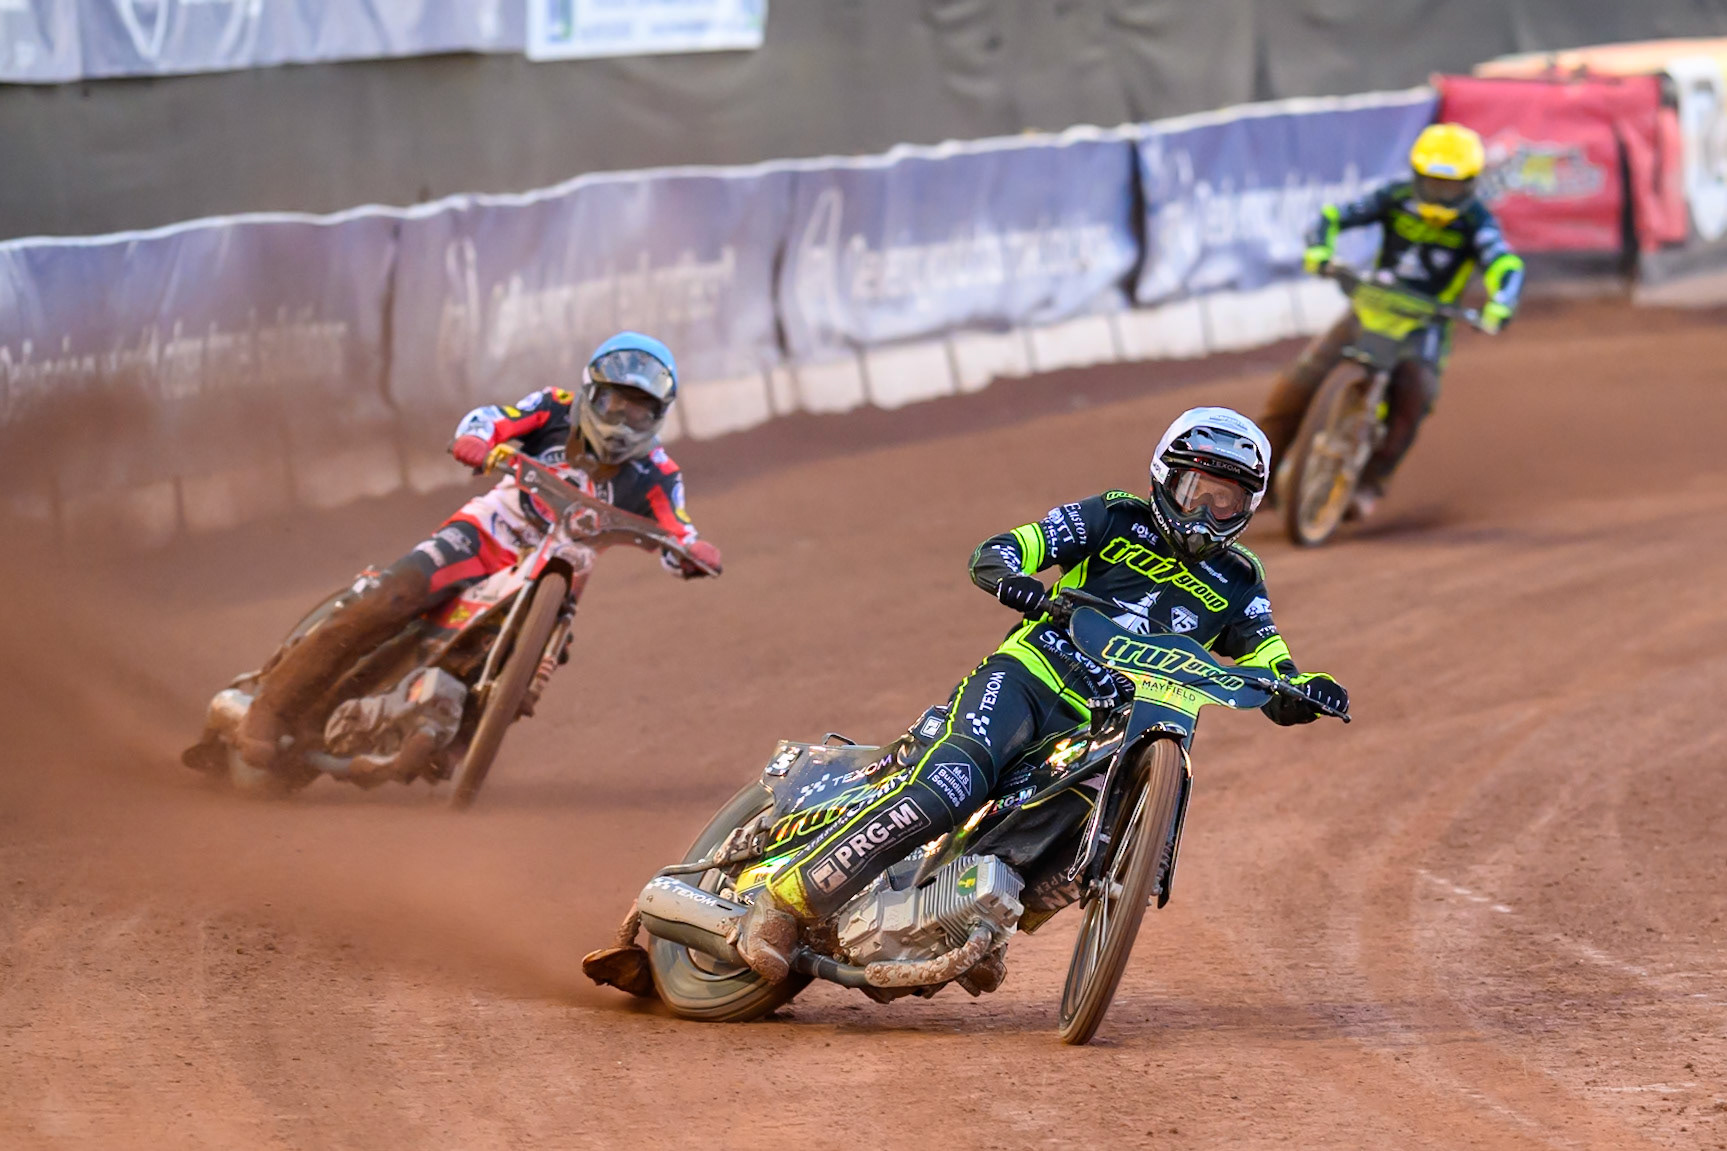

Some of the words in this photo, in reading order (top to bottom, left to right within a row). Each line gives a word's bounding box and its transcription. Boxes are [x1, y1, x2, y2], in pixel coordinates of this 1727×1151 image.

[979, 671, 1006, 711] TEXOM
[1142, 679, 1197, 702] MAYFIELD
[832, 753, 893, 787] TEXOM
[938, 768, 966, 803] Building
[953, 766, 970, 785] MJS
[931, 773, 961, 808] Services
[834, 802, 920, 869] PRG-M
[671, 885, 718, 907] TEXOM
